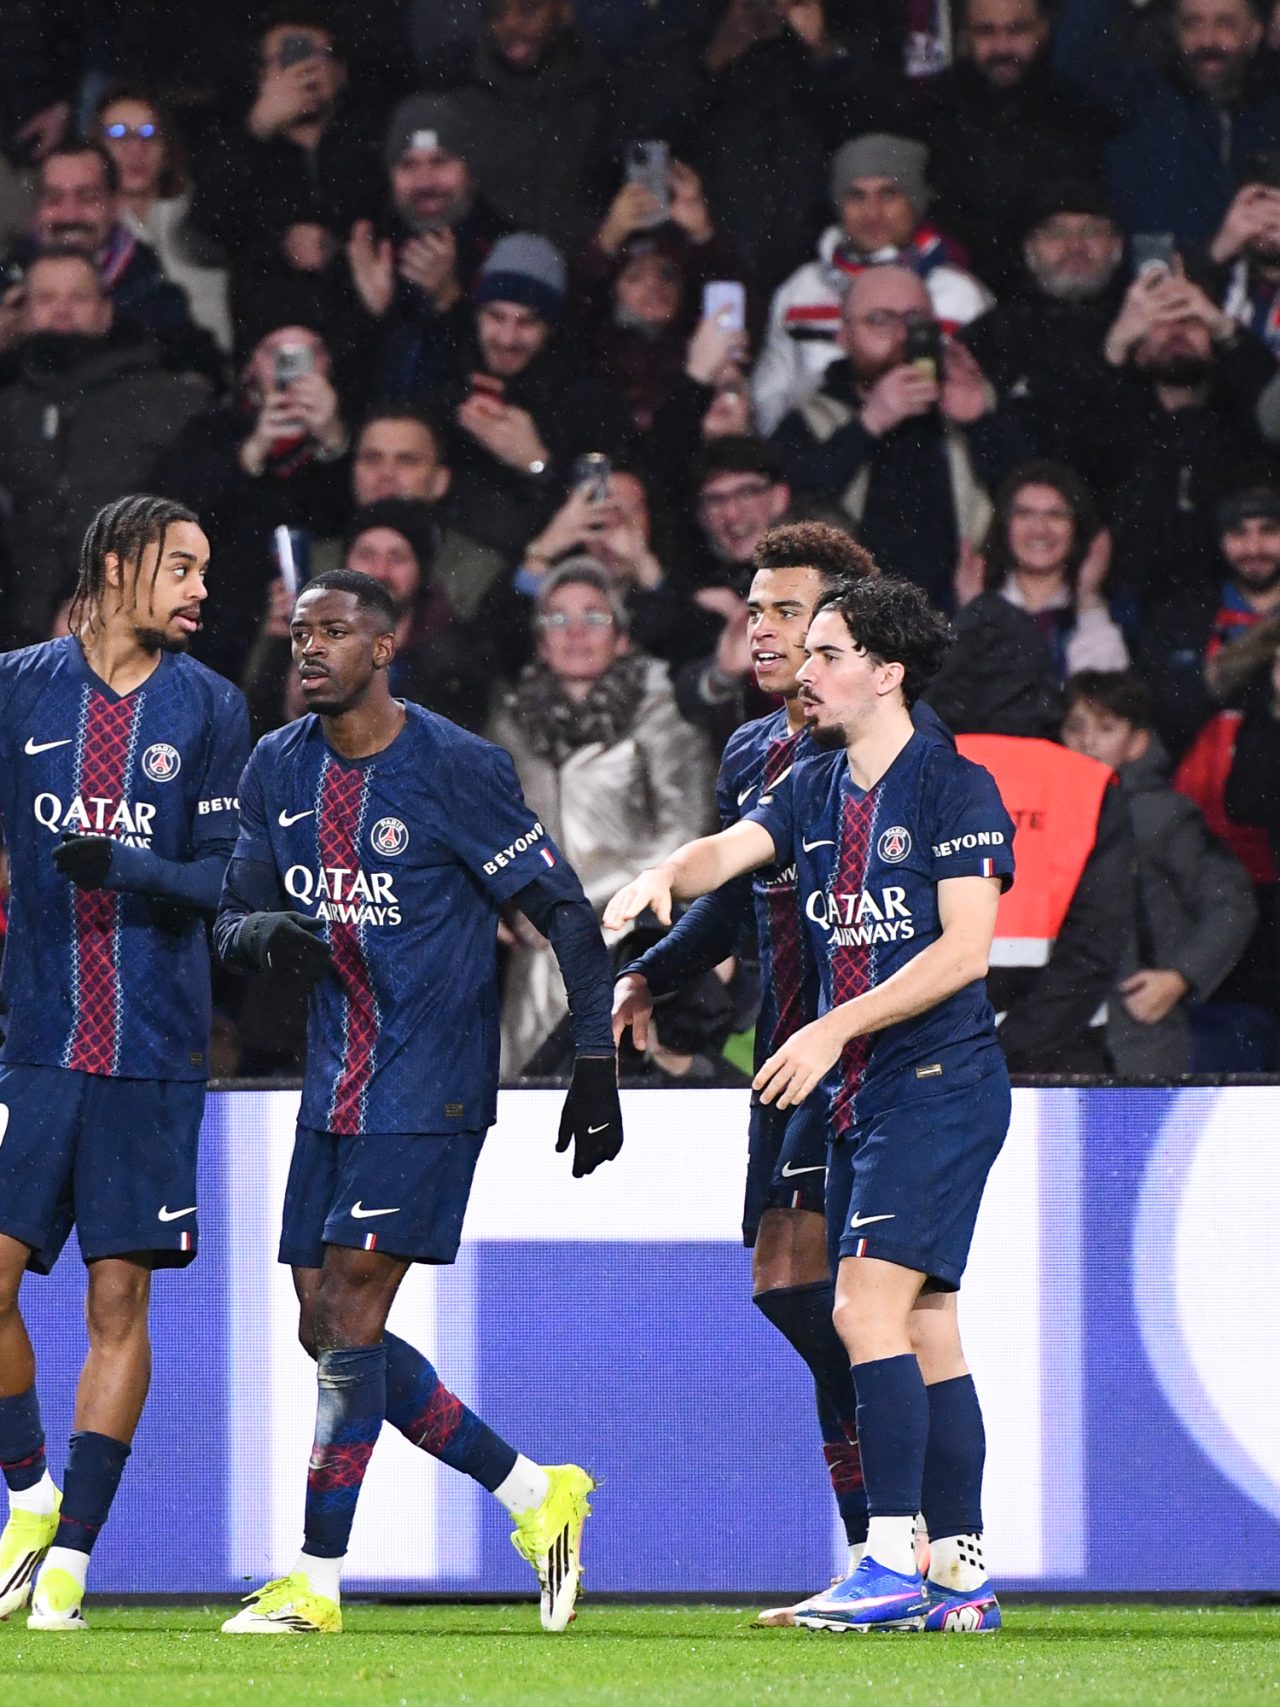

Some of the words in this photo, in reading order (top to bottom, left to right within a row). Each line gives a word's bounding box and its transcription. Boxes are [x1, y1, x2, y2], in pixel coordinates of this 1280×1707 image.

[34, 793, 156, 834] QATAR
[198, 797, 239, 815] BEY
[284, 865, 399, 905] QATAR
[315, 903, 402, 927] AIRWAYS
[805, 886, 912, 931] QATAR
[827, 918, 915, 946] AIRWAYS
